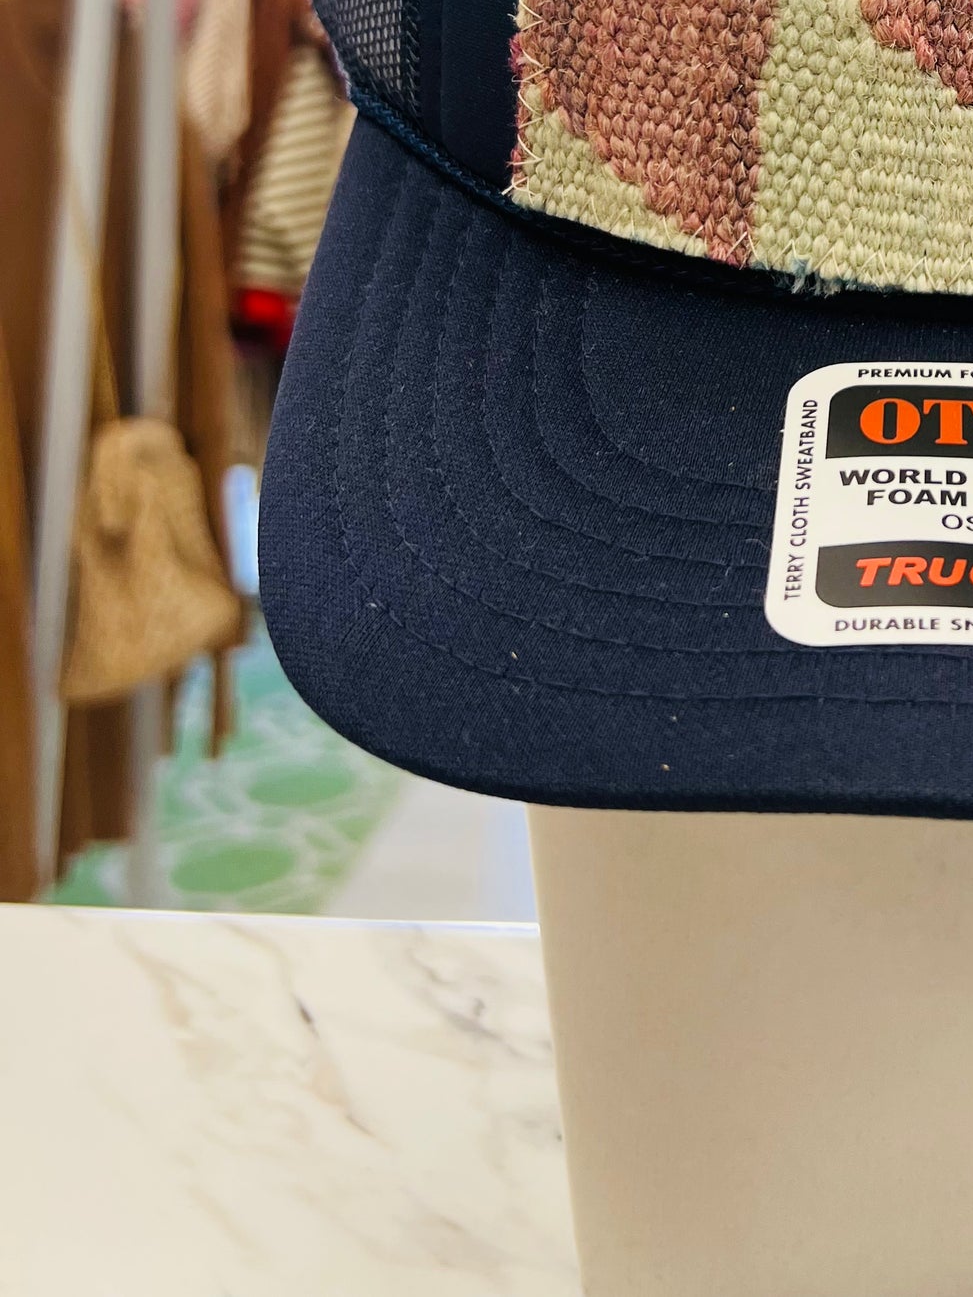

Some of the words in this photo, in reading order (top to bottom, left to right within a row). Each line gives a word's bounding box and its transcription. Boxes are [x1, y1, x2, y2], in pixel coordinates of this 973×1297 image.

[857, 368, 953, 379] PREMIUM
[794, 399, 819, 491] SWEATBAND
[839, 468, 967, 486] WORLD
[866, 489, 968, 506] FOAM
[789, 496, 810, 550] CLOTH
[784, 555, 806, 601] TERRY
[834, 619, 941, 632] DURABLE
